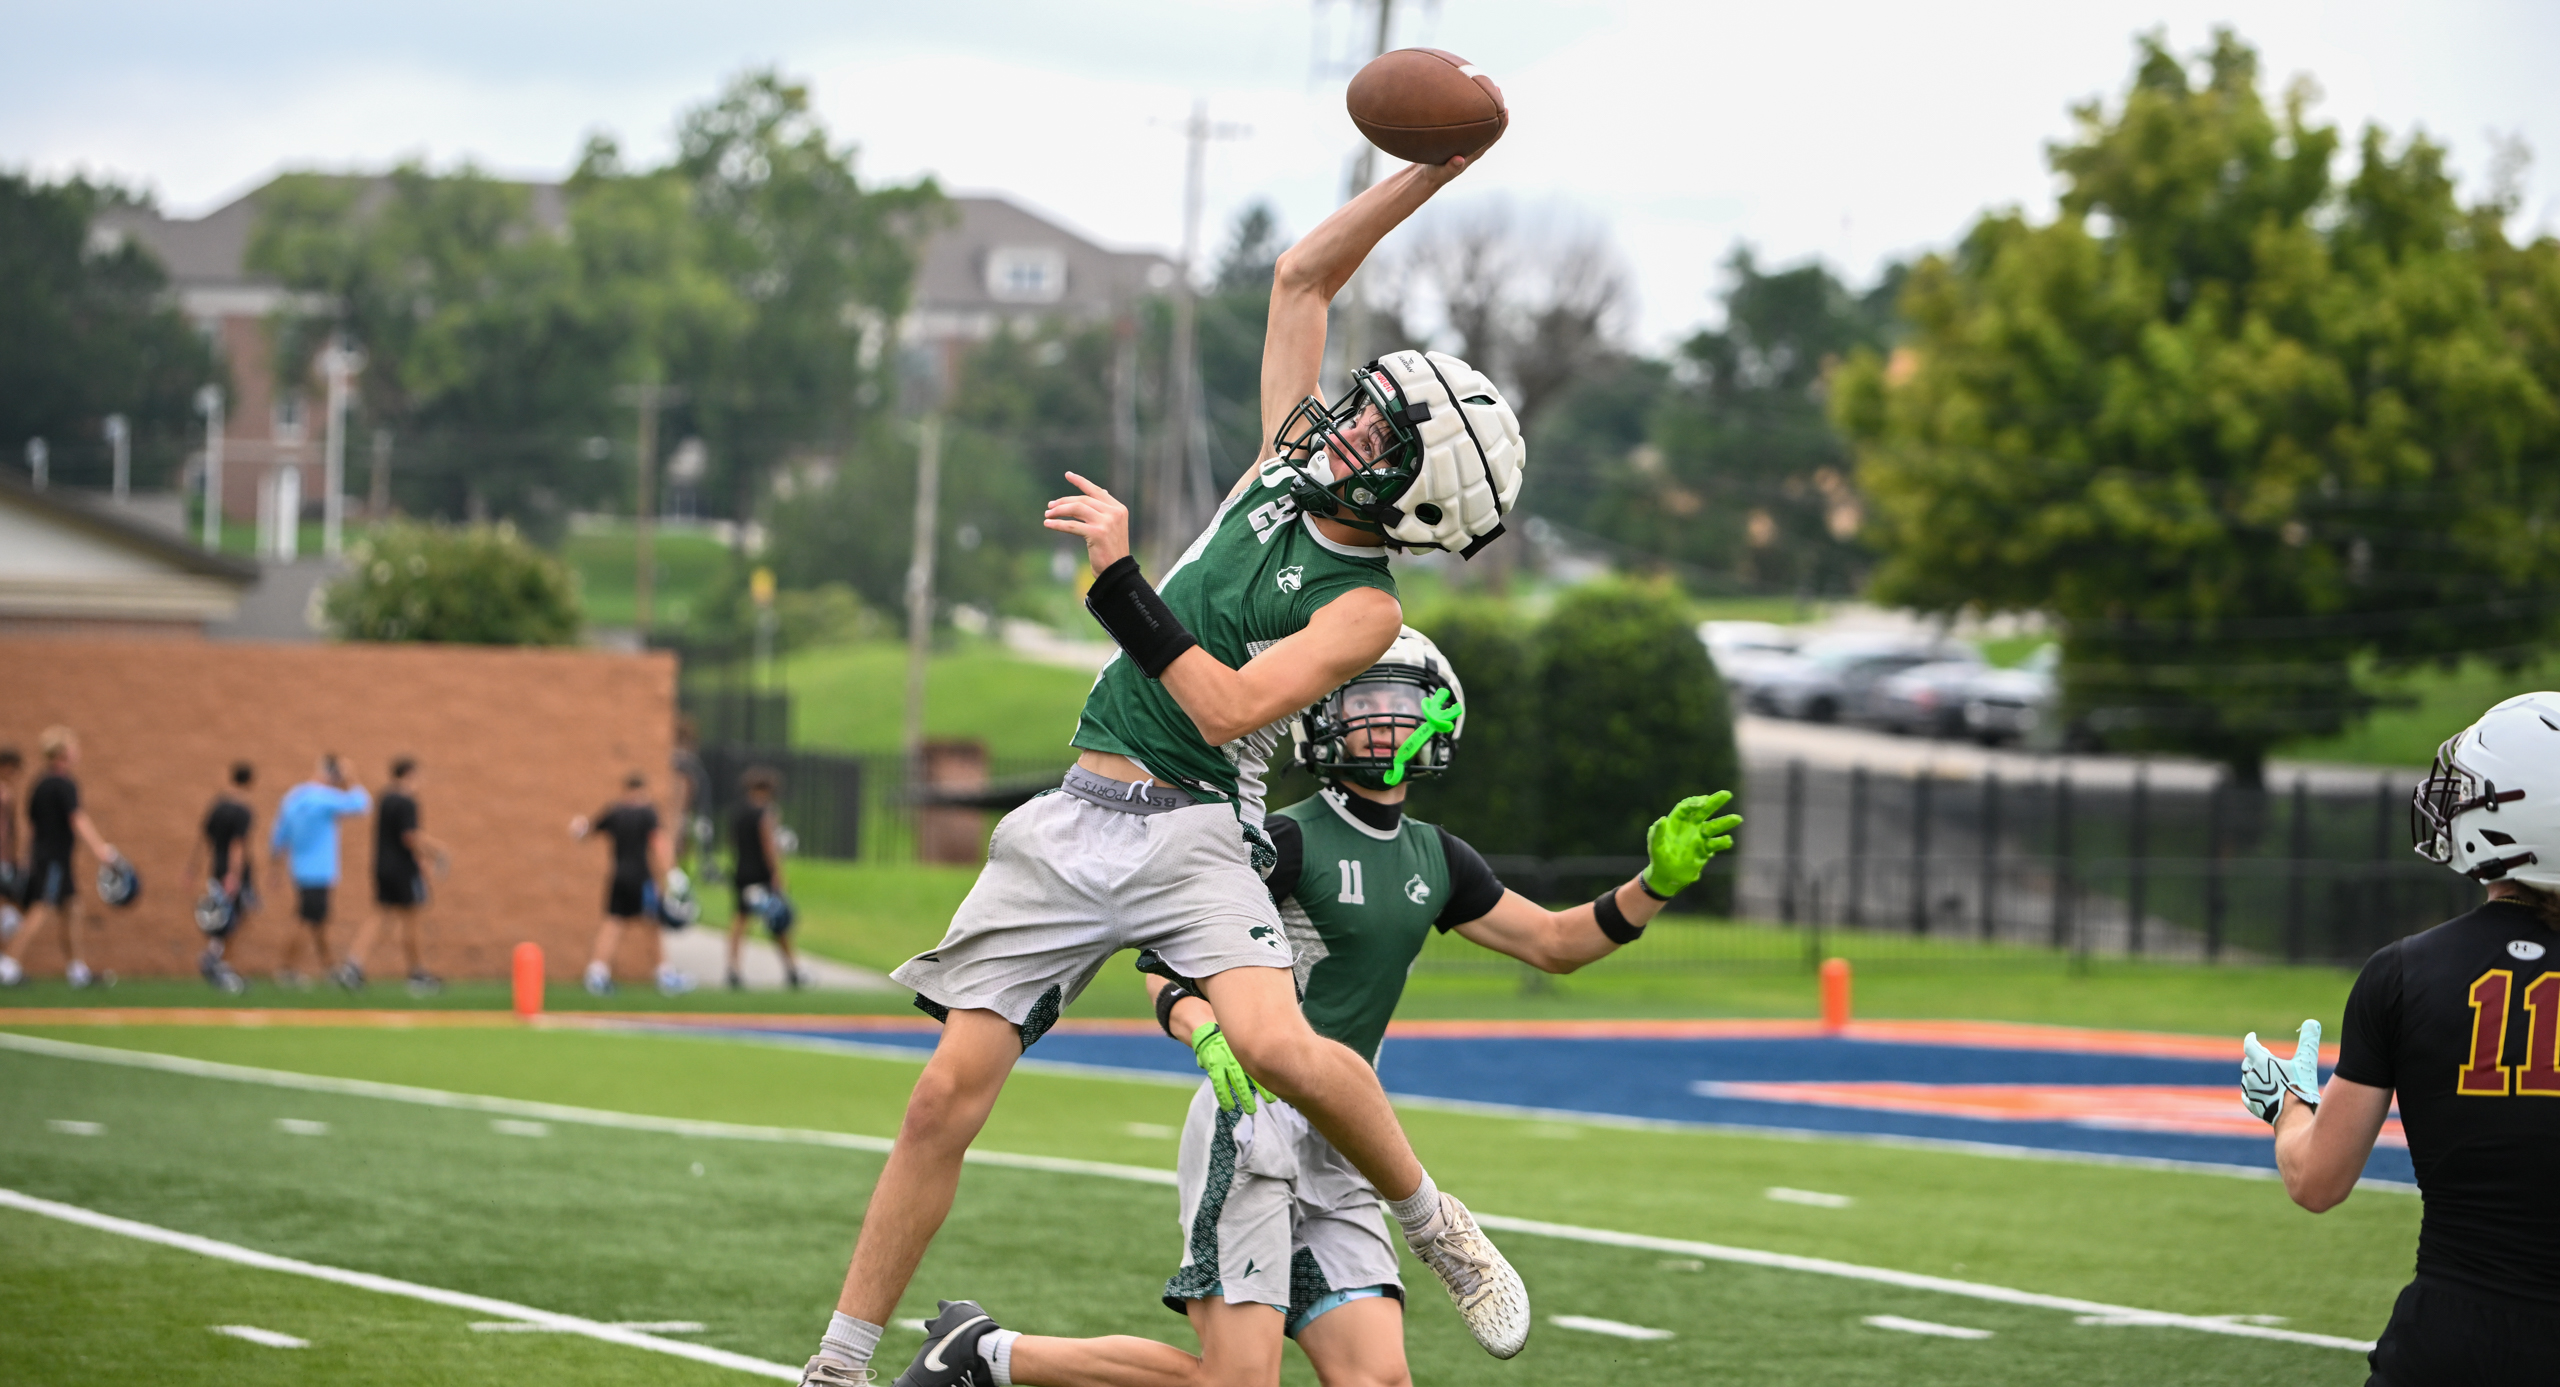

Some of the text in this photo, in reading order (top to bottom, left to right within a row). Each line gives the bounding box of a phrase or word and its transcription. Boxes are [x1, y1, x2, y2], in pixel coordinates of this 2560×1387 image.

[1129, 590, 1160, 631] Riddell
[1082, 780, 1176, 808] BSN PORTS
[1338, 859, 1365, 905] 11
[2457, 968, 2560, 1097] 11
